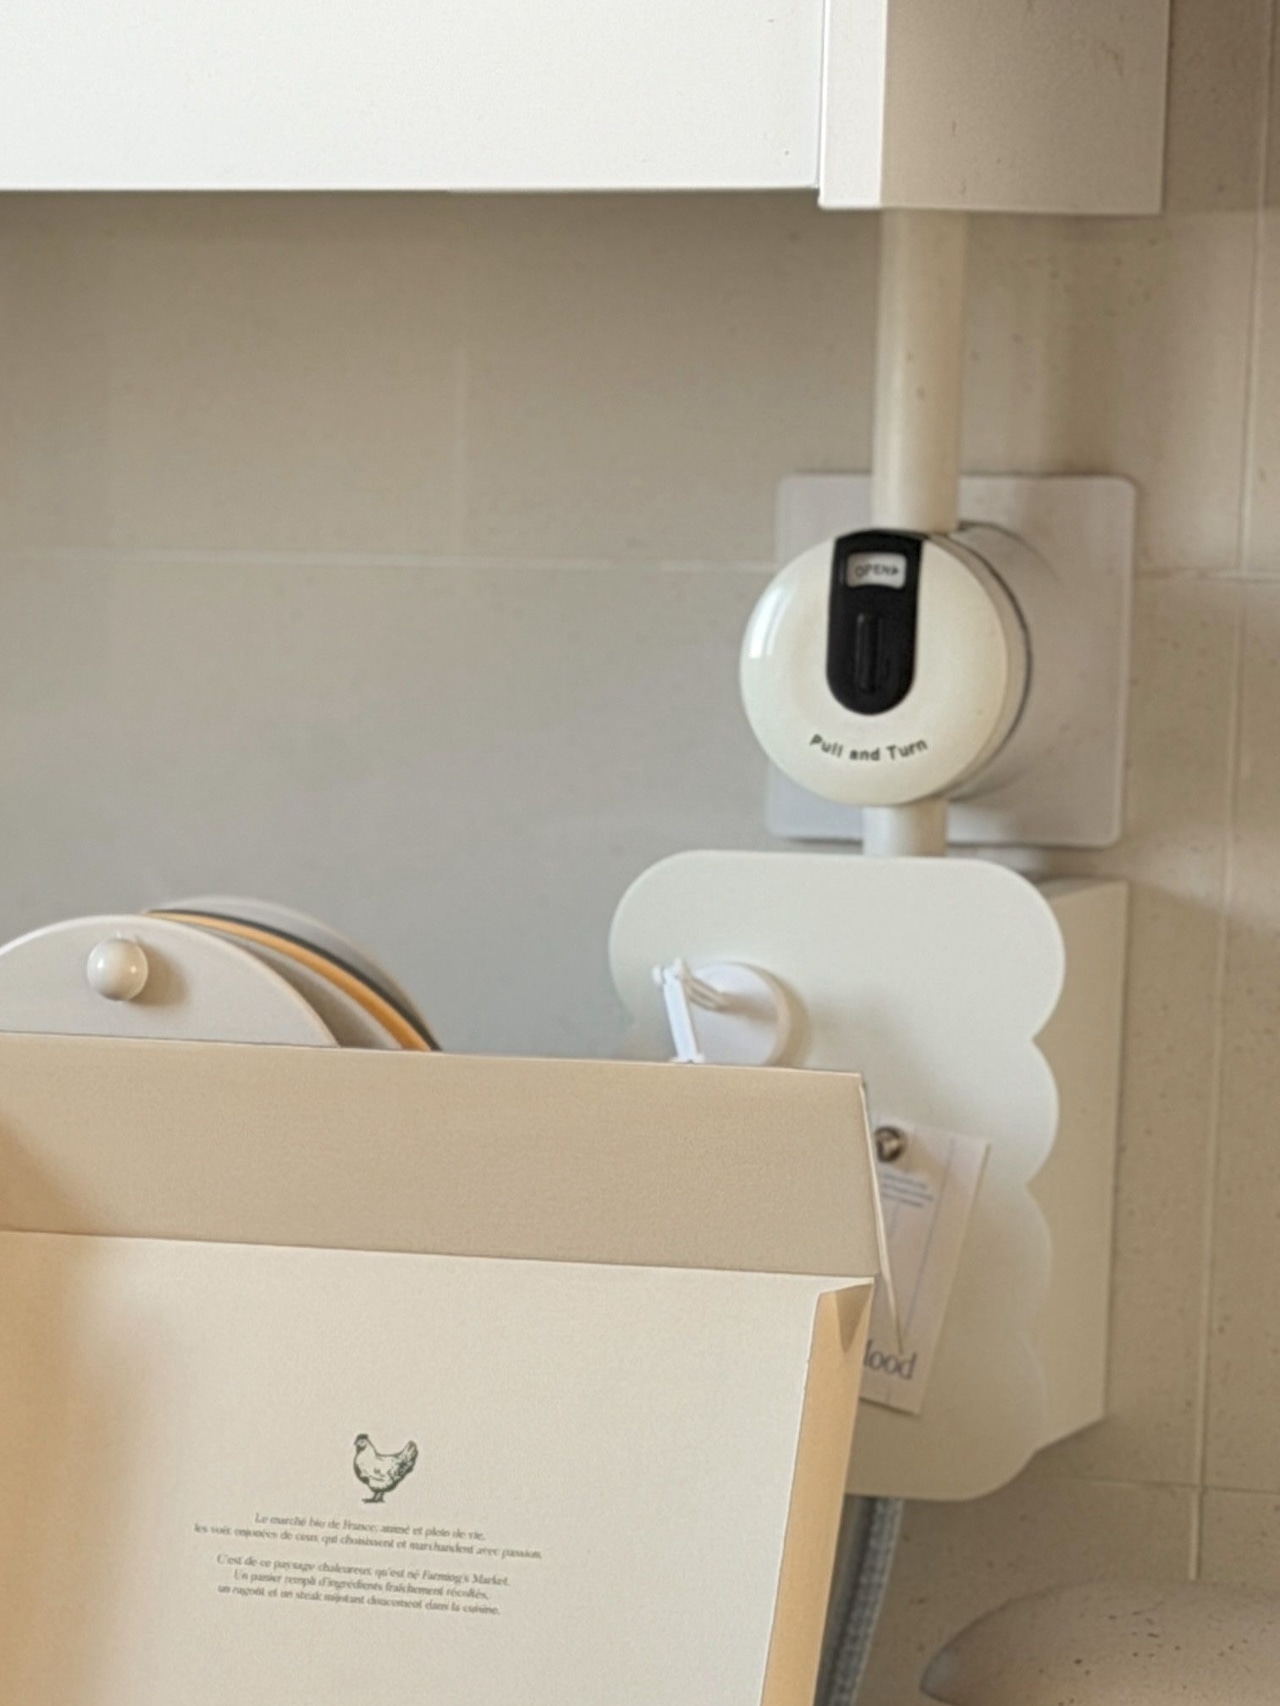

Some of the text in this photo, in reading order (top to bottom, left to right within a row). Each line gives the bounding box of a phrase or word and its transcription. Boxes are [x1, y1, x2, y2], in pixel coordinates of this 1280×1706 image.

[809, 734, 928, 761] Pull and Turn
